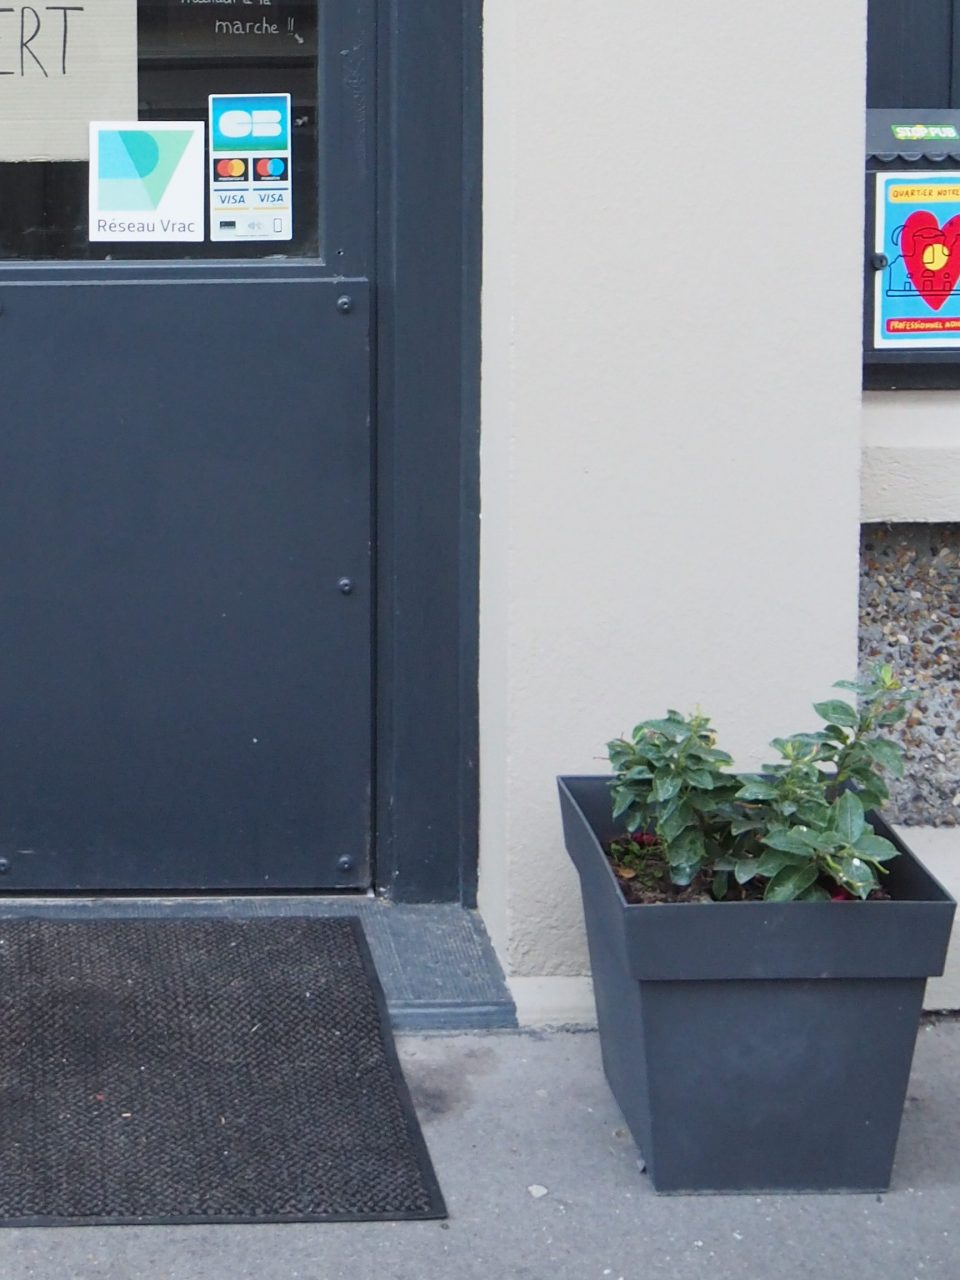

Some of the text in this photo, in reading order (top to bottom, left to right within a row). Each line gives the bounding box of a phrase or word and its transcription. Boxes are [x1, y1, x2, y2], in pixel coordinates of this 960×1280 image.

[214, 16, 280, 35] marche
[219, 193, 285, 205] VISA VISA
[96, 217, 196, 233] Réseau Vrac
